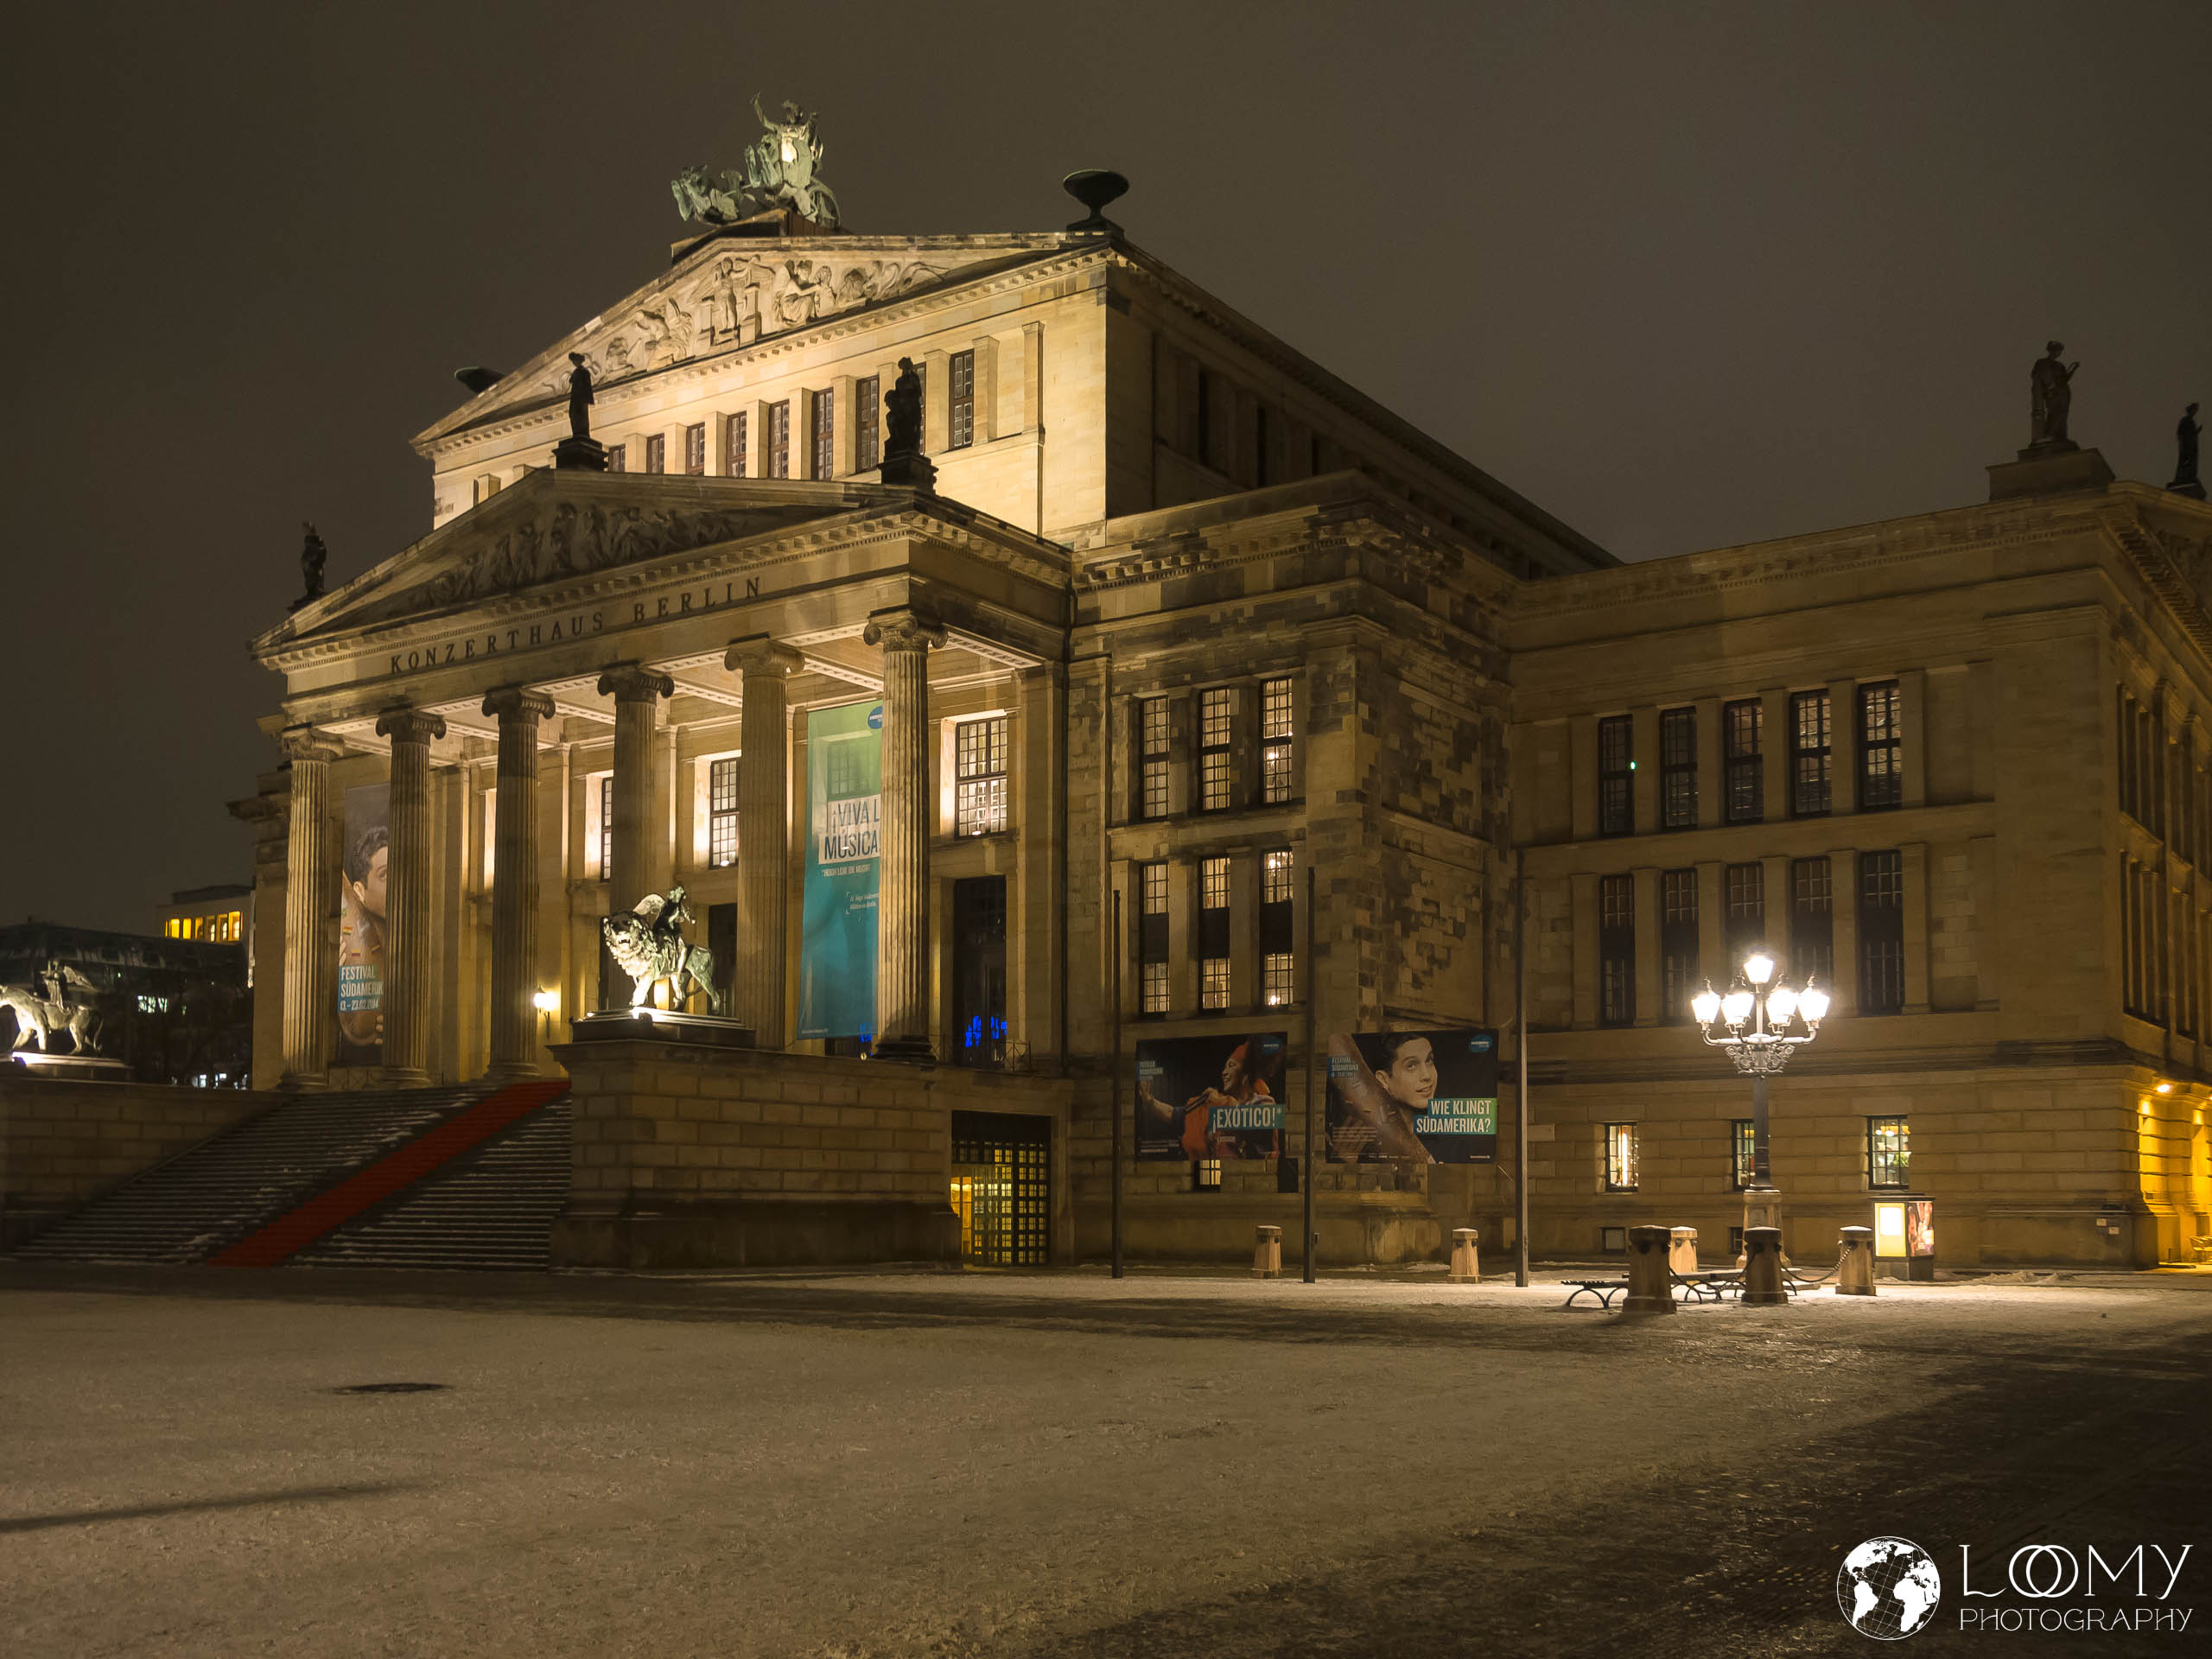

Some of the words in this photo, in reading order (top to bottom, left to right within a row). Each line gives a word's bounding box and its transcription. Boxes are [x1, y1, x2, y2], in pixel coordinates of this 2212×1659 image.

[390, 613, 604, 674] KONZERTHAUS
[633, 576, 760, 624] BERLIN
[832, 800, 869, 835] ¡VIVA
[873, 798, 880, 823] L
[823, 829, 880, 861] MÚSICA
[340, 966, 375, 981] FESTIVAL
[340, 982, 384, 997] SÜDAMERIK
[1430, 1100, 1450, 1116] WIE
[1452, 1099, 1491, 1115] KLINGT
[1416, 1116, 1491, 1134] SÜDAMERIKA?
